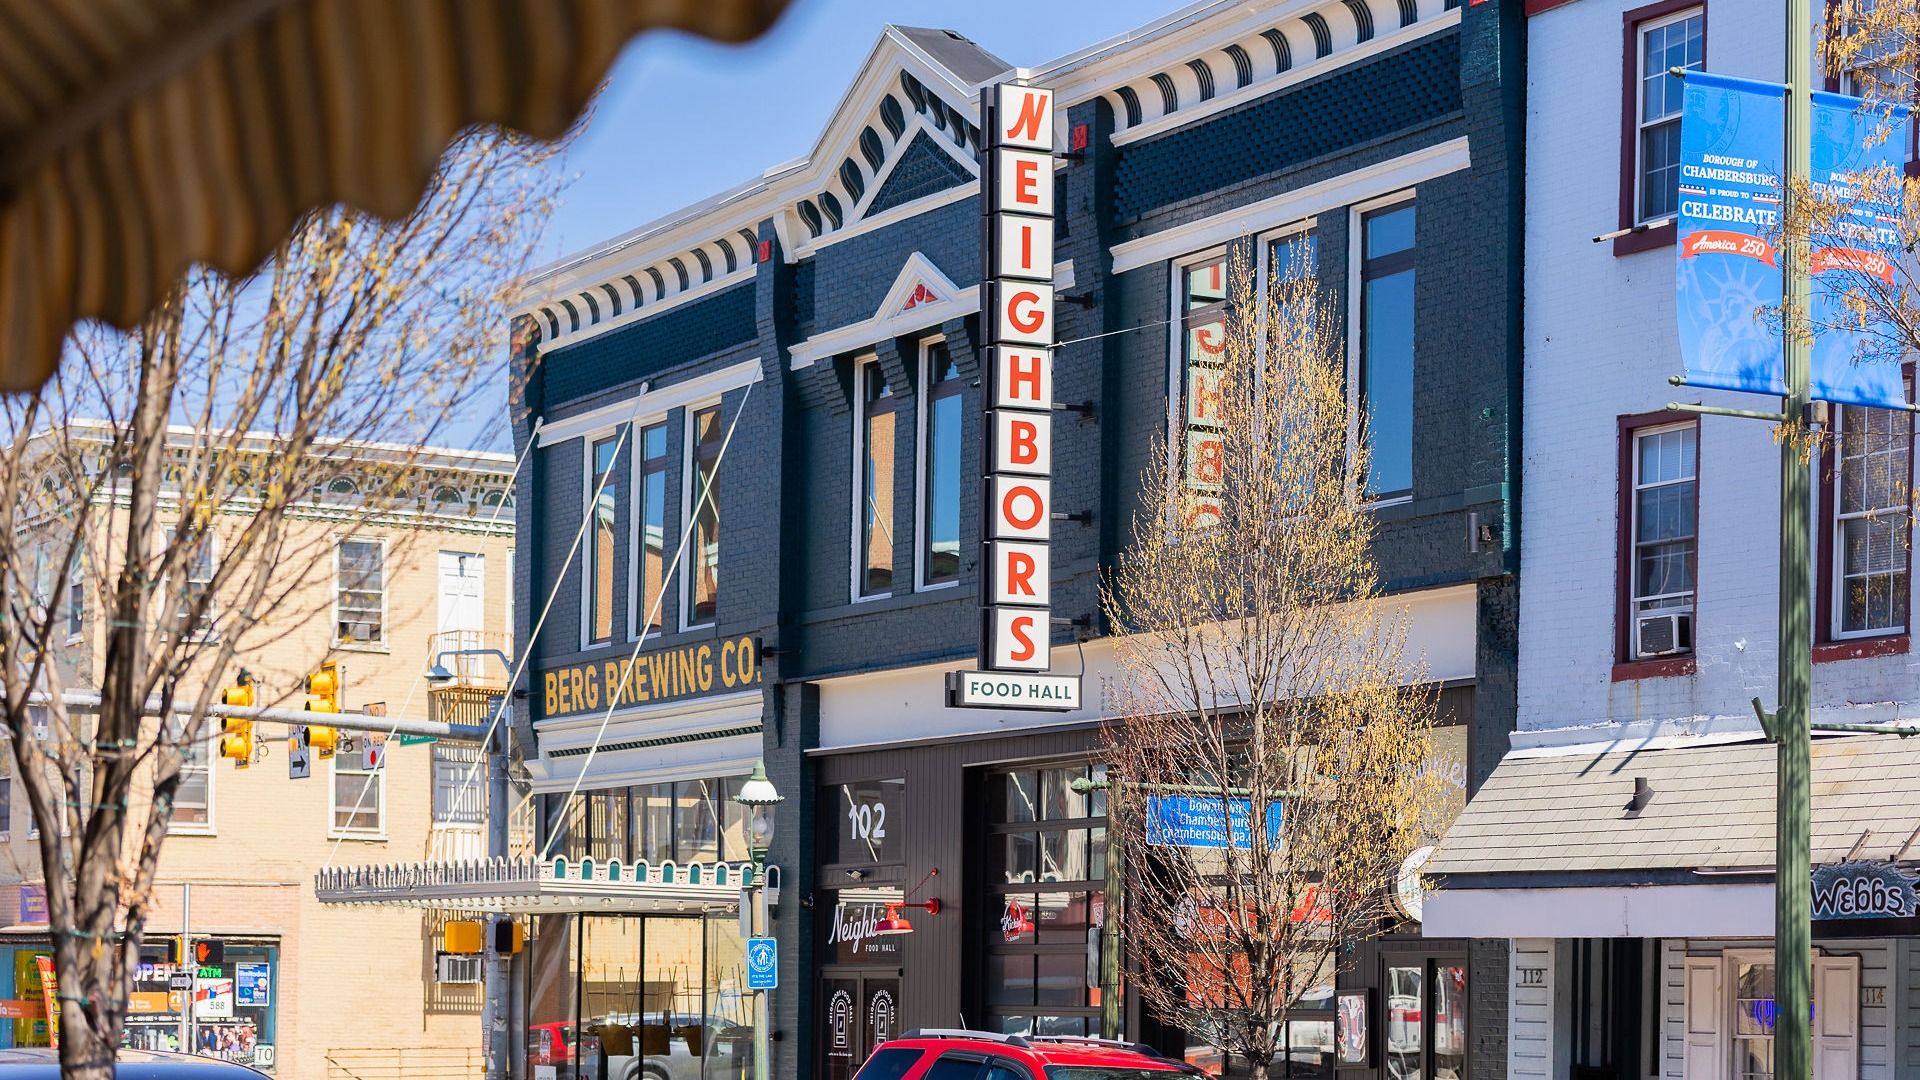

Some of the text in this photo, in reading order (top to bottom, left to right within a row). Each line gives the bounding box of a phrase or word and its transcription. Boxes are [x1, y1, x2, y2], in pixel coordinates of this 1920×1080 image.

[1703, 154, 1758, 169] BOROUGH OF
[1682, 165, 1778, 187] CHAMBERSBURG
[1709, 188, 1750, 199] IS PROUD TO
[1681, 200, 1777, 226] CELEBRATE
[1692, 234, 1766, 257] America 250
[1863, 256, 1886, 275] 250
[1002, 92, 1047, 662] NEIGHBORS
[545, 664, 599, 716] BERG
[604, 643, 713, 707] BREWING
[970, 681, 1072, 700] FOOD HALL
[1189, 799, 1242, 814] Downtwn
[848, 802, 886, 840] 102
[1809, 876, 1906, 917] Webbs
[828, 902, 888, 954] Neighb
[865, 944, 896, 952] FOOD HALL
[201, 967, 222, 978] ATM
[1522, 968, 1543, 984] 112
[209, 1001, 225, 1010] 588
